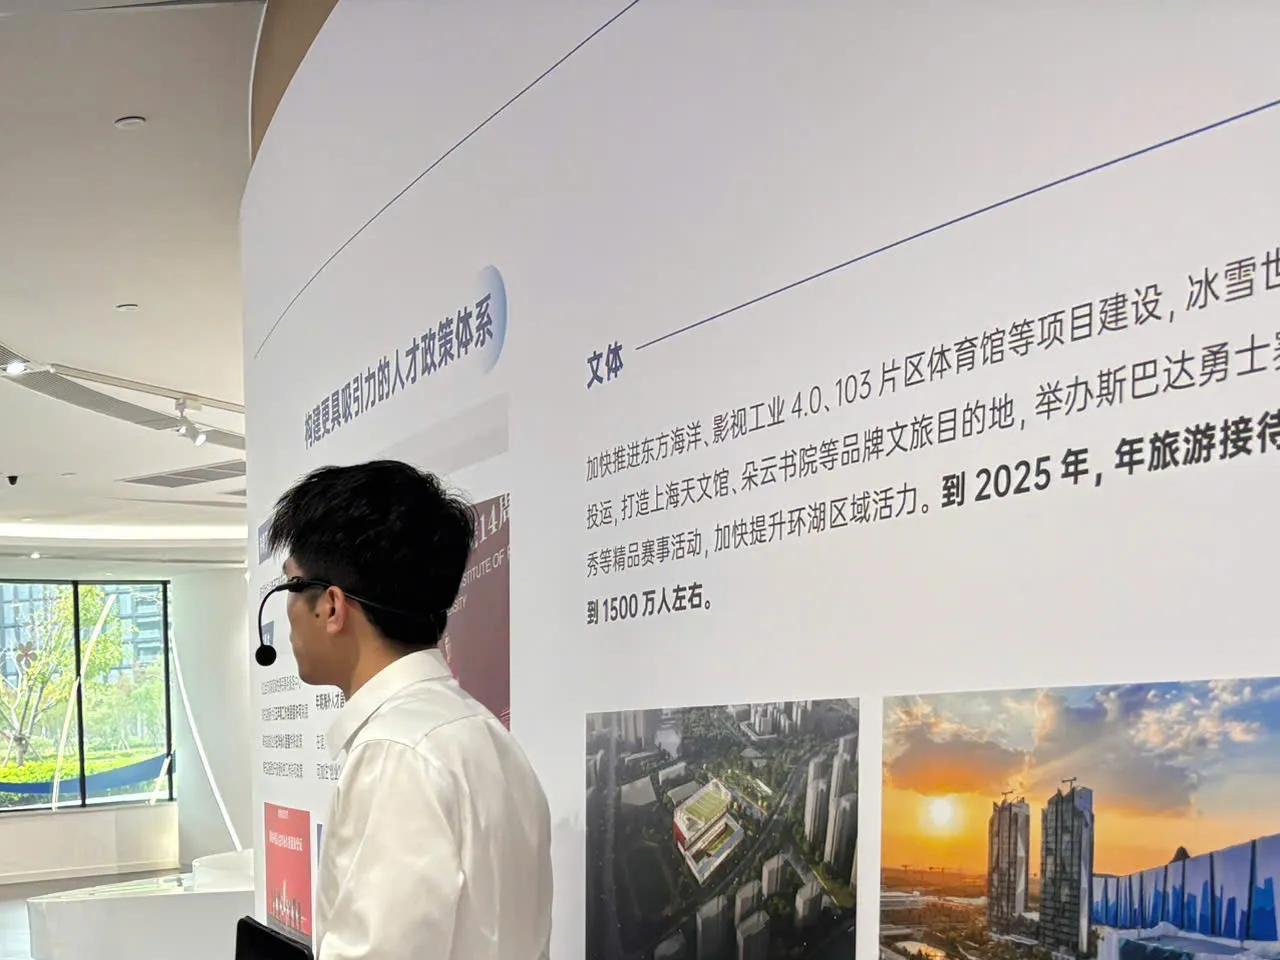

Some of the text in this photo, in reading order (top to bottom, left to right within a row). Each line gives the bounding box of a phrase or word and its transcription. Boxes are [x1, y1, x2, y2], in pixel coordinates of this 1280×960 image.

[304, 293, 494, 449] 构建更具吸引力的人才政策体系
[587, 341, 624, 389] 文体
[461, 557, 492, 587] STITUTE
[492, 548, 505, 568] OF
